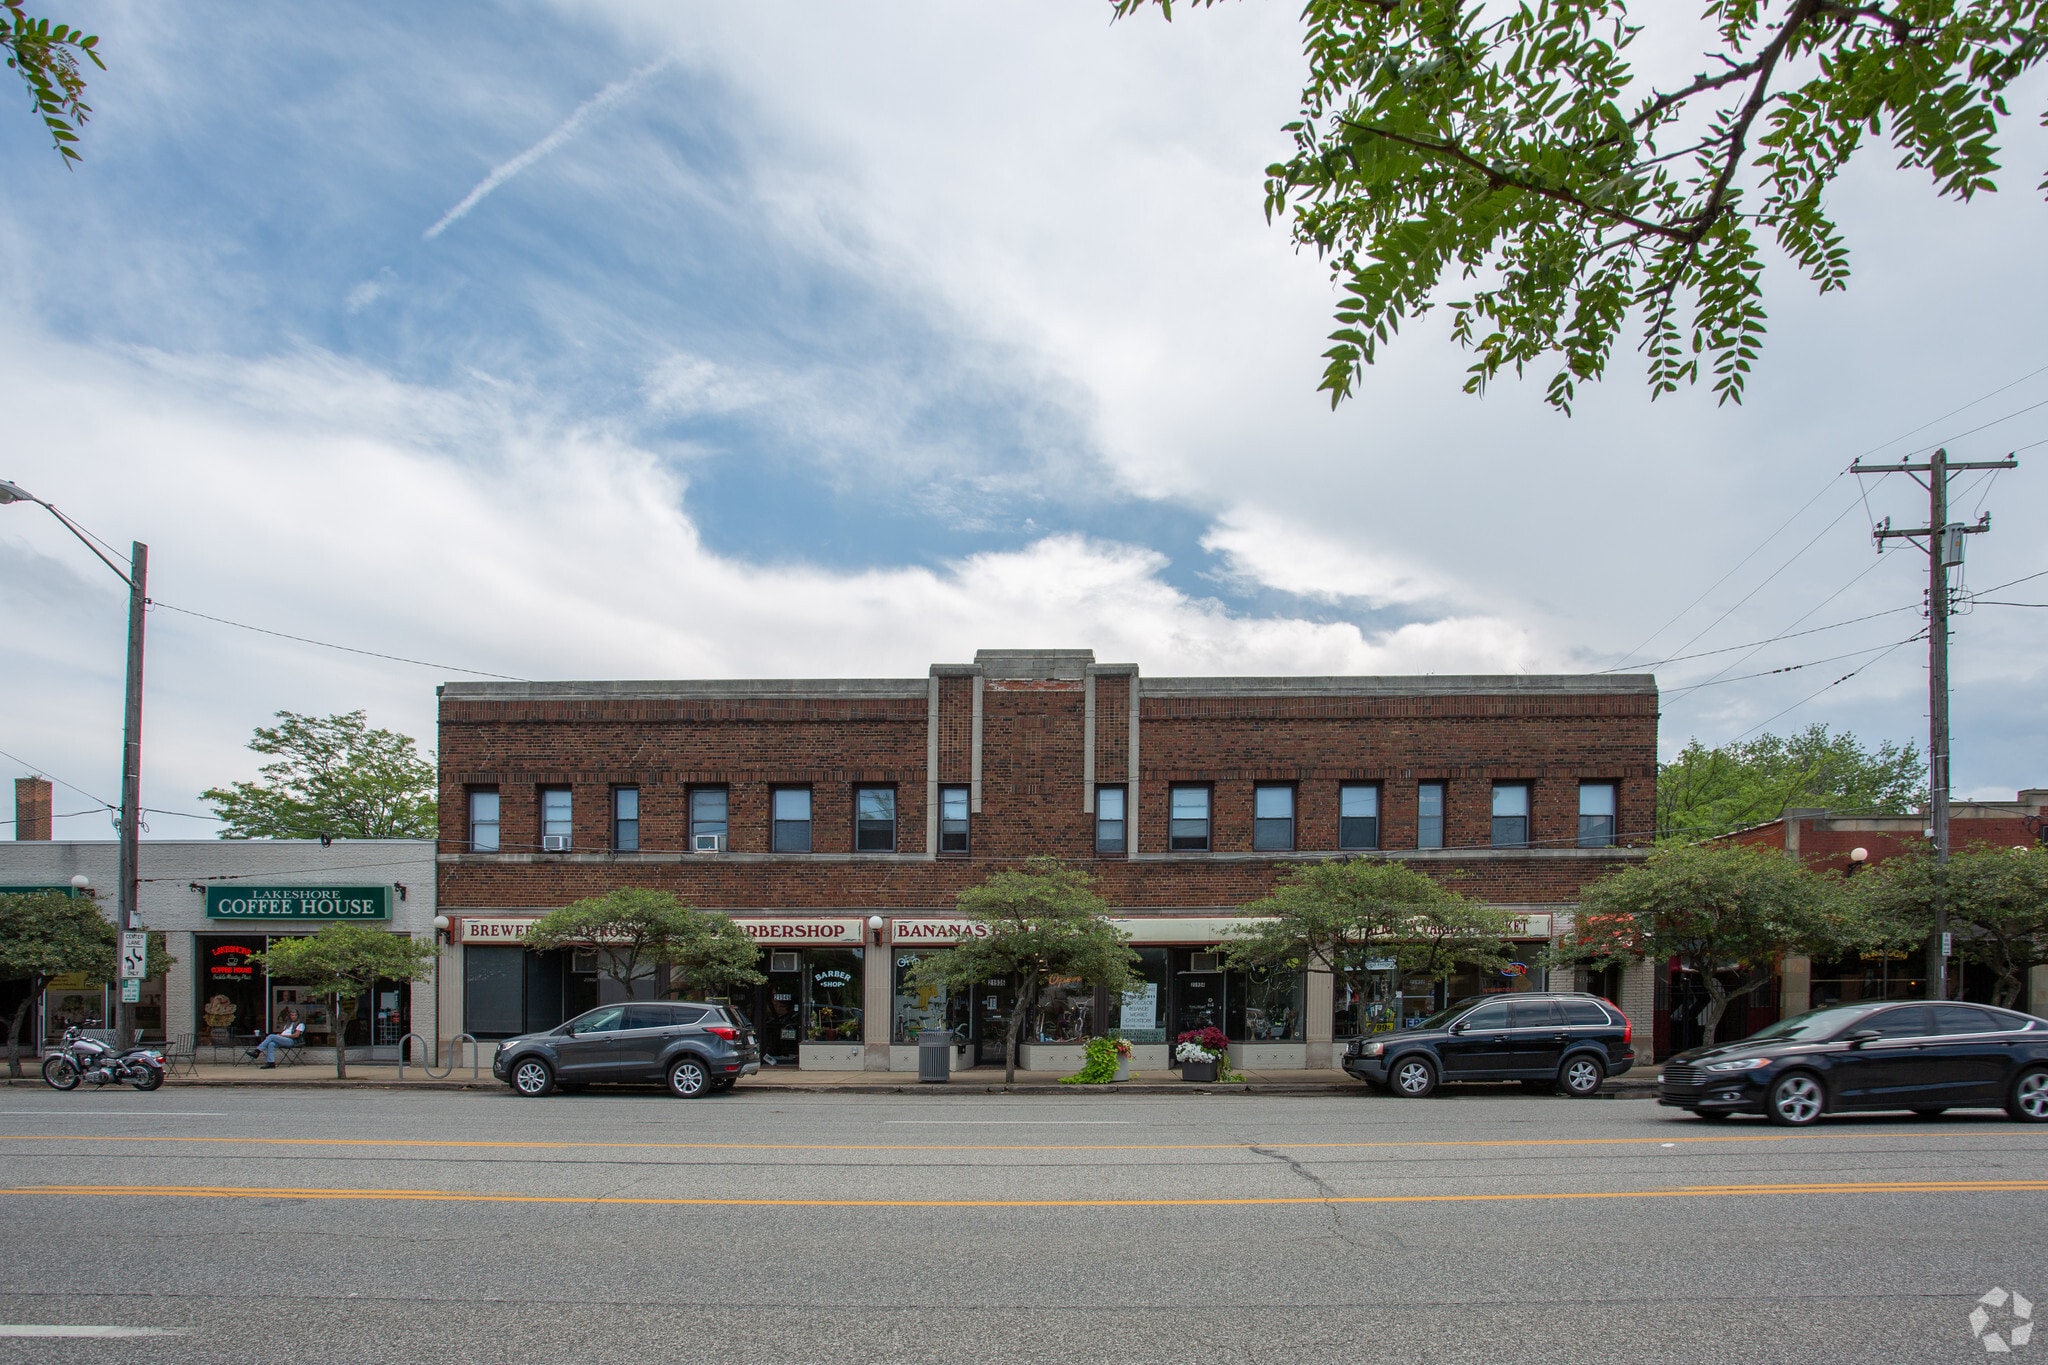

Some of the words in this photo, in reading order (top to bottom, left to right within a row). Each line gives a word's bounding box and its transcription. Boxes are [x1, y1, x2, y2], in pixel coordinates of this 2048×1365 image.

[252, 890, 341, 899] LAKESHORE
[218, 899, 293, 914] COFFEE
[300, 899, 375, 915] HOUSE
[897, 924, 988, 938] BANANAS
[210, 966, 233, 974] COFFEE
[233, 966, 253, 974] HOUSE
[814, 970, 852, 982] BARBER
[1048, 973, 1083, 988] Open
